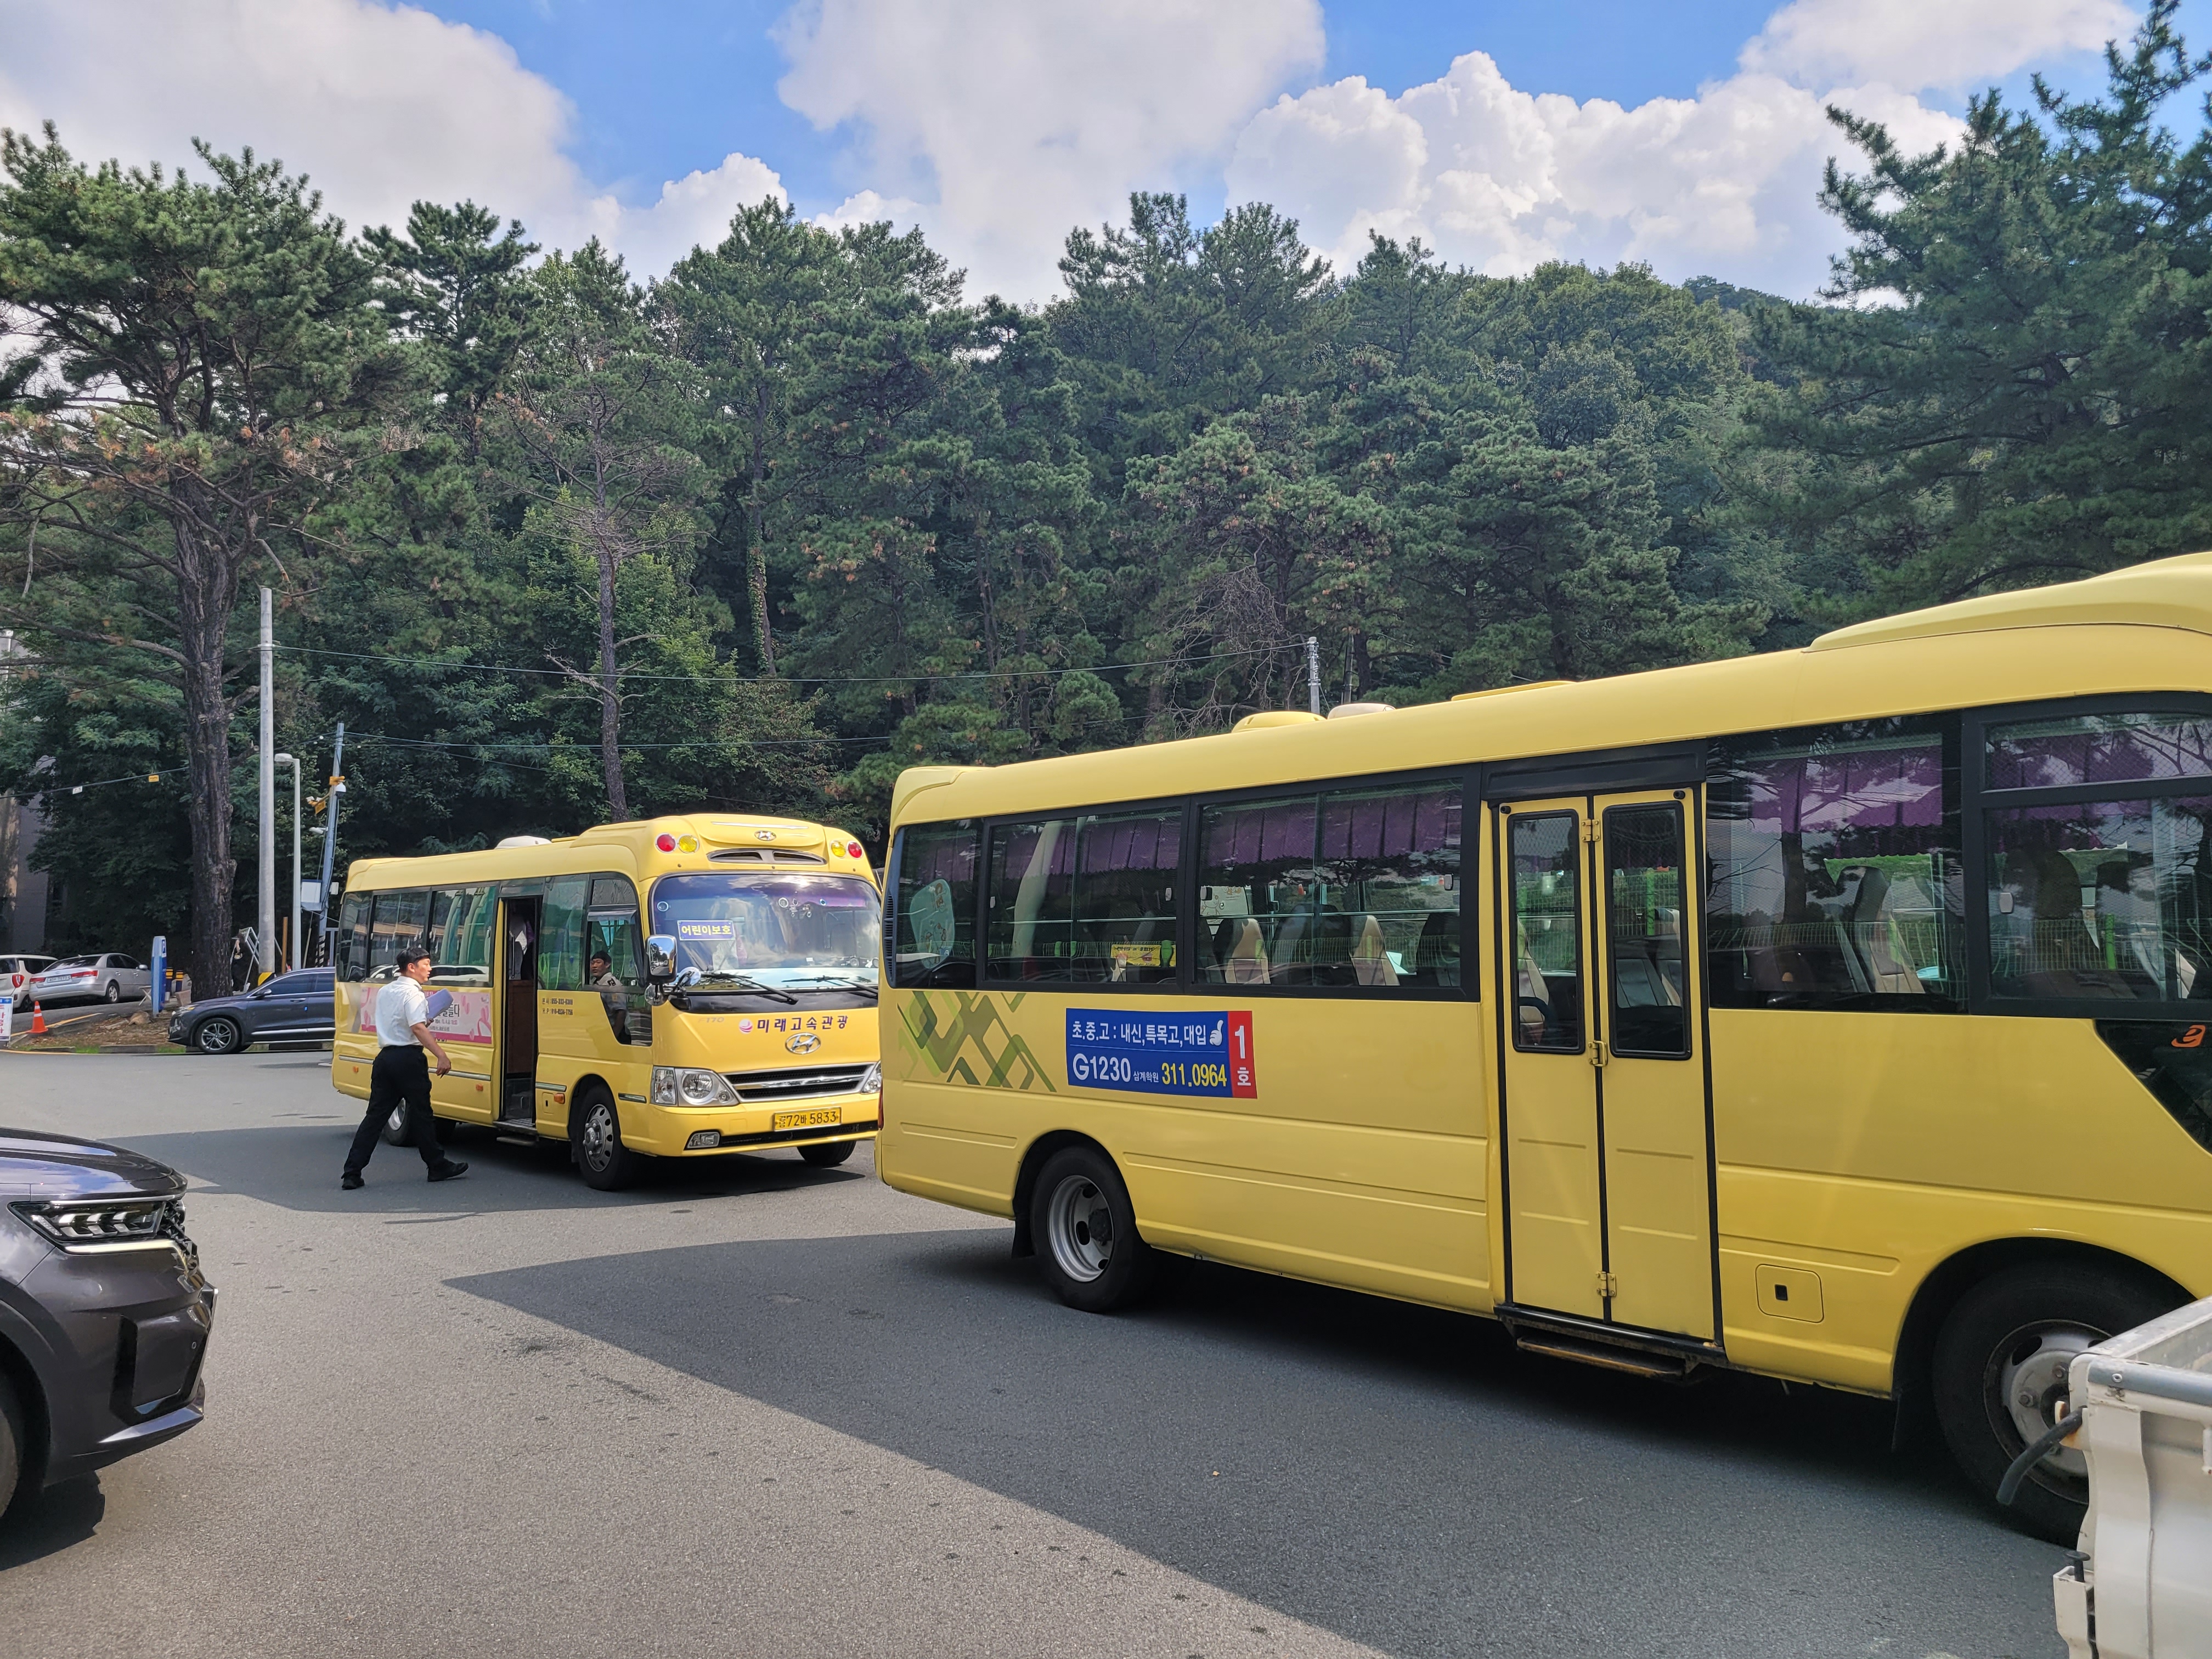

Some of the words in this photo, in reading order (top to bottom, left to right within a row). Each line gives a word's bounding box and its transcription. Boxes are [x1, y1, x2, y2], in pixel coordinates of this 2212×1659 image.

[681, 925, 732, 935] 어린이보호
[757, 1015, 849, 1033] 미래고속관광
[1073, 1053, 1131, 1082] G1230
[1133, 1071, 1159, 1083] 삼계학원
[1161, 1063, 1227, 1087] 311.0964
[809, 1111, 837, 1125] 5833
